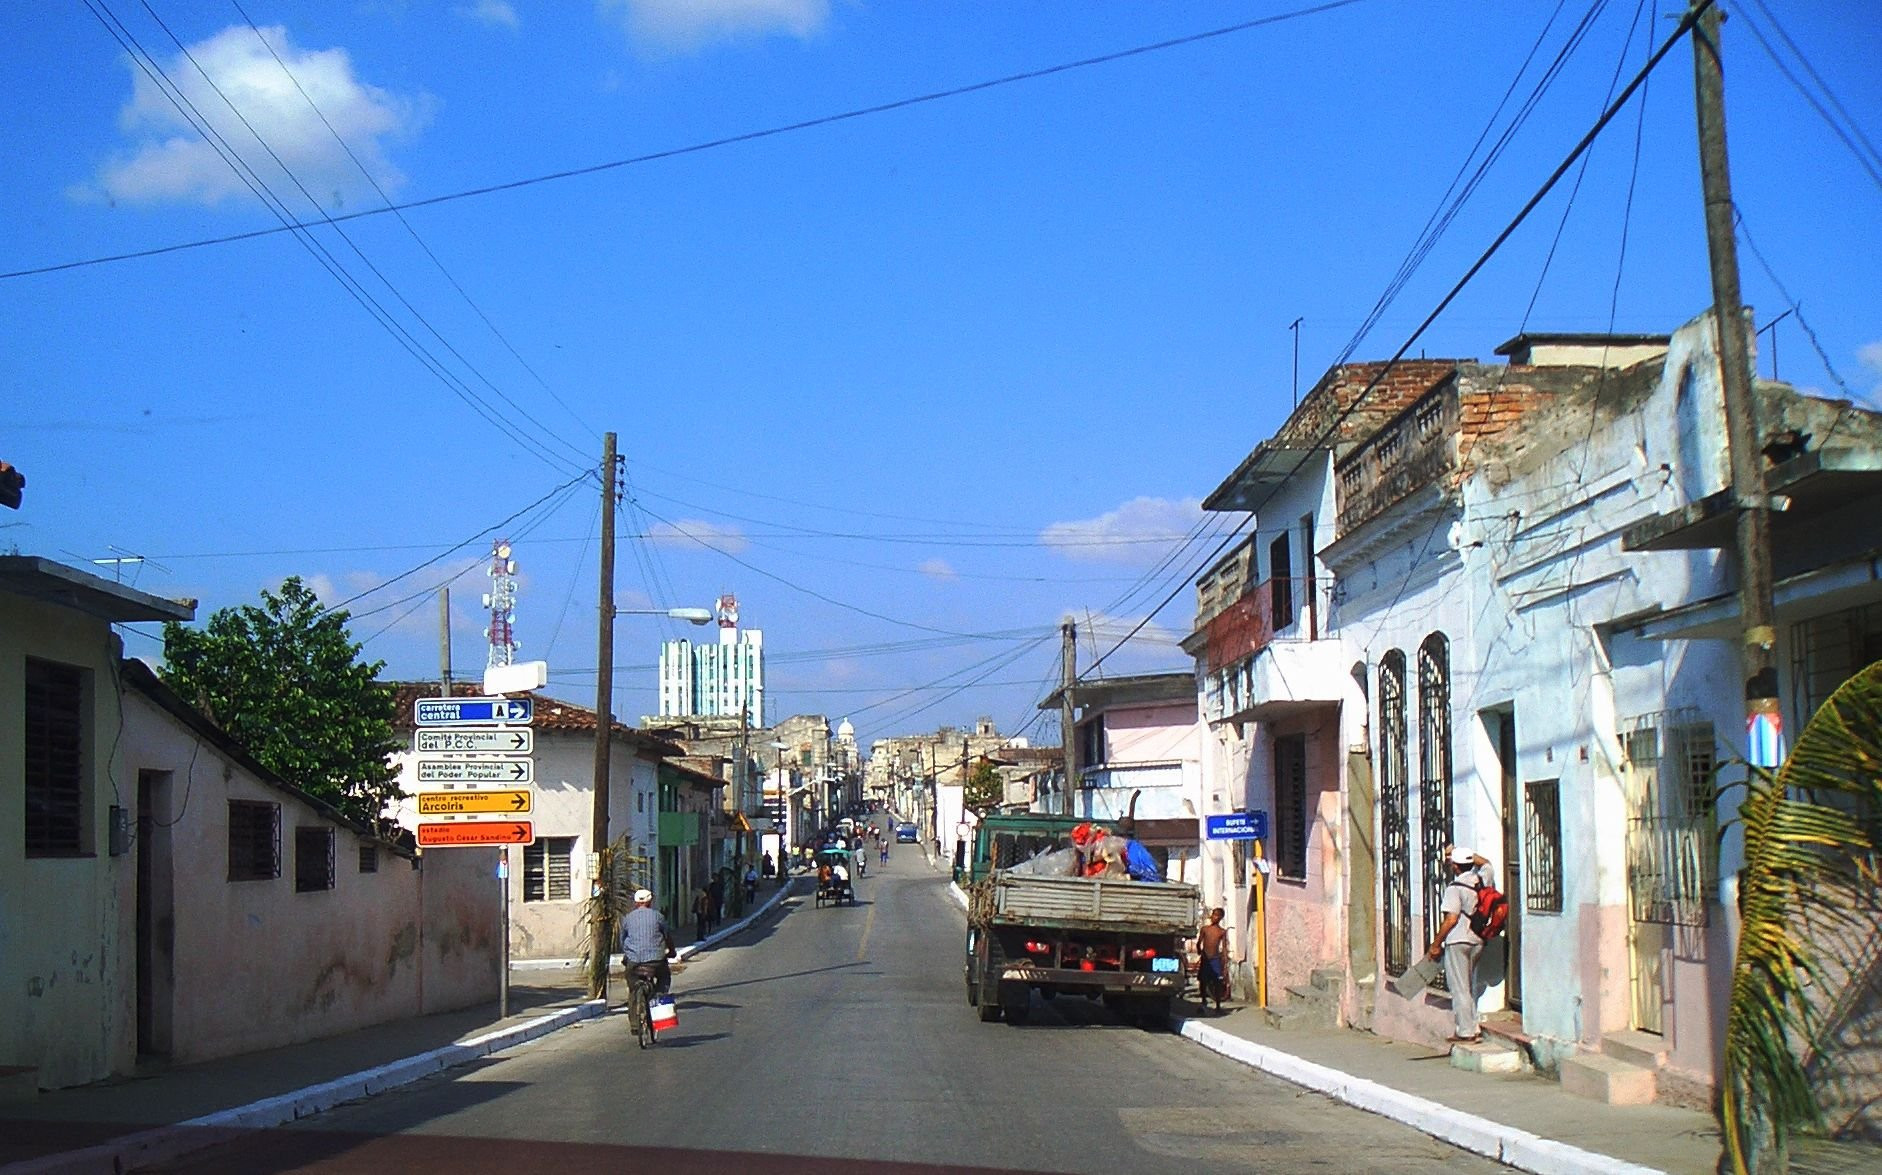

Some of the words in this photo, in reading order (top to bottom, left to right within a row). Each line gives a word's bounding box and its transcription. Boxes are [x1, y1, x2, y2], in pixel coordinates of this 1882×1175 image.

[420, 704, 460, 712] carretera
[496, 704, 504, 717] A
[420, 711, 460, 720] central
[421, 741, 438, 749] del
[445, 741, 477, 749] P.C.C.
[468, 771, 500, 780] Popular
[480, 832, 511, 840] Sandino
